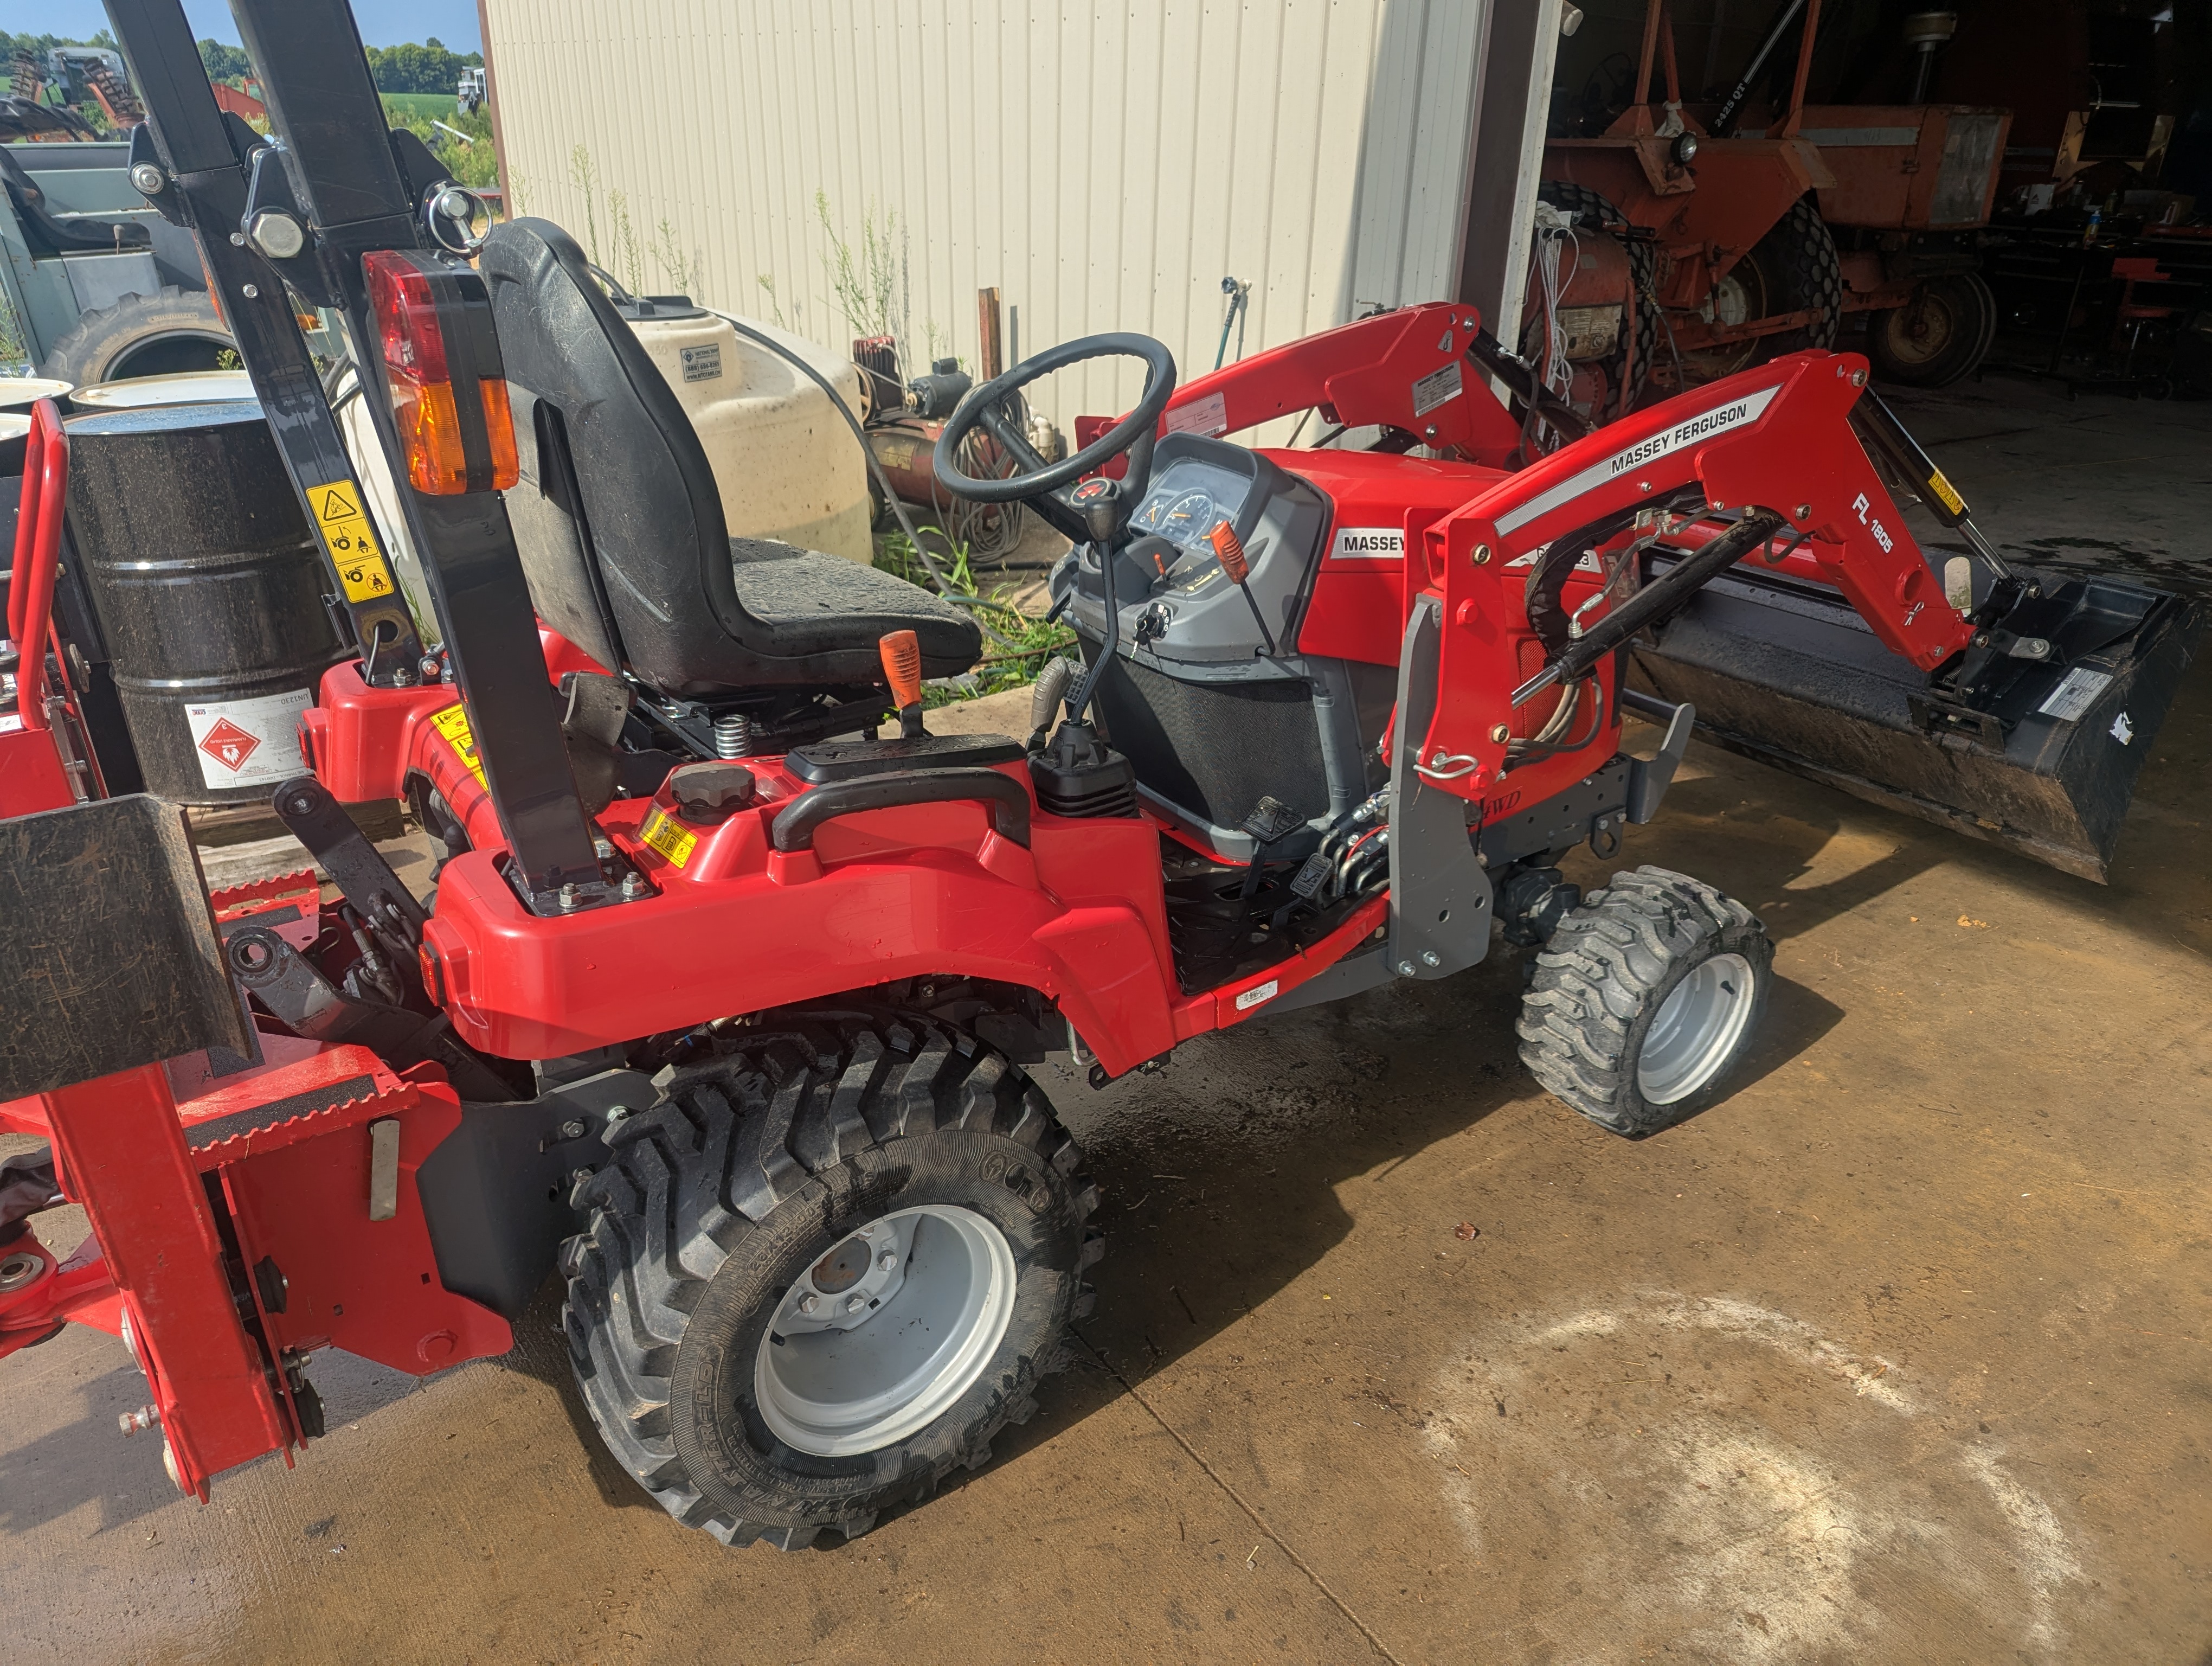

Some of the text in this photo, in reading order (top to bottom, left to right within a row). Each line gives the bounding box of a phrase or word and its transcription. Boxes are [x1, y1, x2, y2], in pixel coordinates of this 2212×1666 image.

[1714, 82, 1745, 127] 2425 QT
[1612, 403, 1747, 475] MASSEY FERGUSON
[1852, 492, 1893, 554] FL 1805
[1344, 536, 1404, 551] MASSEY
[281, 693, 308, 705] UN1230
[281, 770, 304, 780] METHANOL
[1483, 790, 1521, 820] 4WD
[841, 1169, 874, 1194] NHS
[695, 1361, 788, 1508] MASTER-LD
